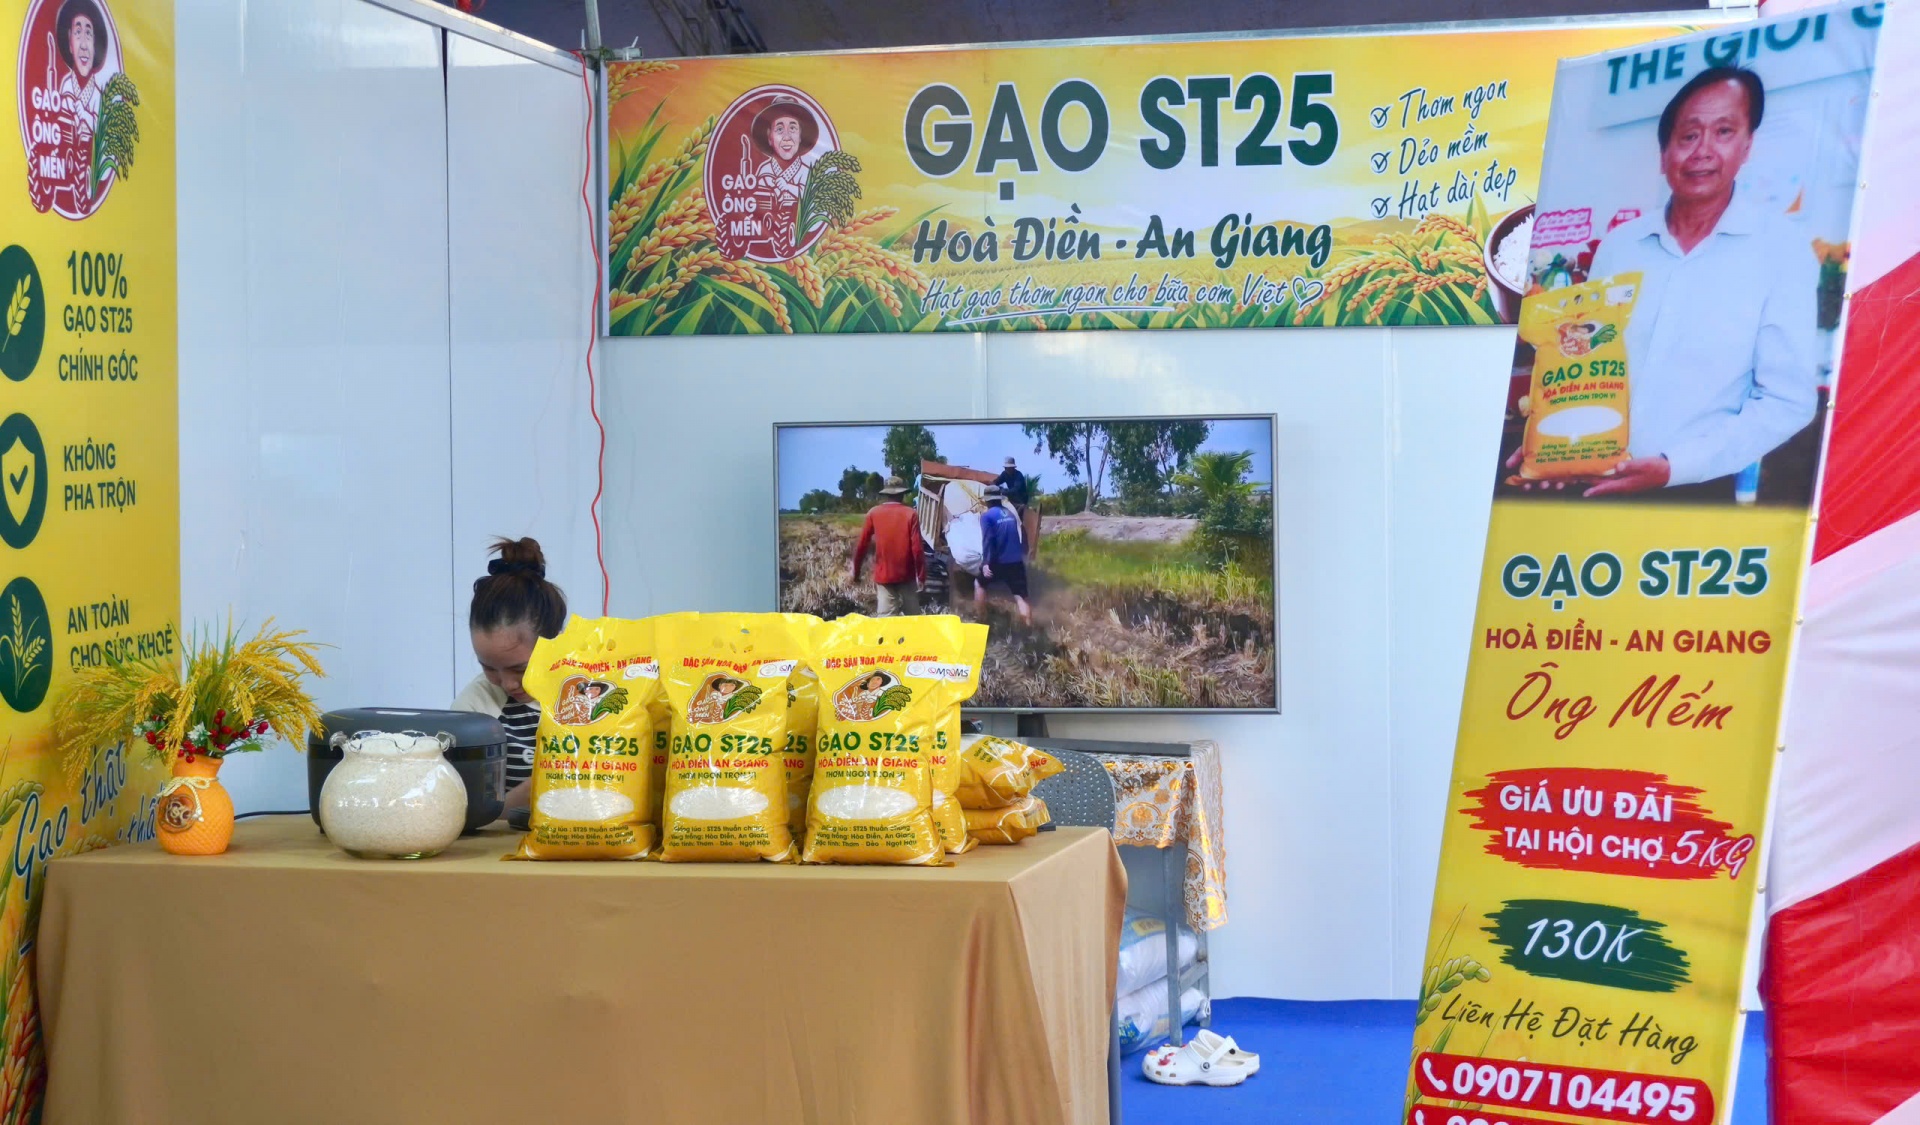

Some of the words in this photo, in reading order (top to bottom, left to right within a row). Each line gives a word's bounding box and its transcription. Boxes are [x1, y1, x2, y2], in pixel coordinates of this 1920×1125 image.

[31, 86, 61, 117] GẠO
[1399, 88, 1455, 128] Thơm
[1463, 80, 1508, 120] ngon
[32, 115, 62, 145] ÔNG
[905, 79, 1109, 200] GẠO
[1139, 73, 1339, 171] ST25
[39, 149, 66, 180] MẾN
[1399, 137, 1439, 175] Dẻo
[1447, 123, 1489, 159] mềm
[722, 173, 757, 195] GẠO
[1398, 179, 1441, 221] Hạt
[1447, 170, 1478, 203] dài
[1483, 159, 1517, 202] đẹp
[721, 195, 757, 213] ÔNG
[730, 213, 762, 237] MẾN
[913, 216, 999, 265] Hoà
[1010, 202, 1100, 262] Điền
[1135, 214, 1196, 260] An
[1210, 212, 1333, 269] Giang
[67, 250, 128, 299] 100%
[919, 278, 962, 313] Hạt
[966, 286, 1000, 319] gạo
[1009, 276, 1056, 308] thơm
[1061, 284, 1108, 316] ngon
[1112, 273, 1148, 304] cho
[1154, 273, 1189, 304] bữa
[1196, 280, 1232, 304] cơm
[1241, 271, 1287, 314] Việt
[63, 305, 96, 339] GẠO
[100, 307, 133, 334] ST25
[58, 347, 104, 382] CHÍNH
[107, 348, 138, 381] GỐC
[1541, 363, 1583, 387] GẠO
[1589, 359, 1626, 378] ST25
[1568, 393, 1590, 402] NGON
[1583, 382, 1596, 392] AN
[1598, 381, 1625, 392] GIANG
[63, 437, 117, 472] KHÔNG
[64, 483, 95, 512] PHA
[97, 476, 136, 513] TRỘN
[1502, 552, 1622, 610] GẠO
[1640, 548, 1769, 596] ST25
[67, 606, 88, 635] AN
[91, 594, 130, 629] TOÀN
[70, 645, 102, 674] CHO
[105, 631, 135, 667] SỨC
[137, 623, 174, 660] KHOẺ
[1485, 622, 1538, 650] HOÀ
[1546, 618, 1603, 651] ĐIỀN
[1625, 630, 1664, 652] AN
[1673, 629, 1771, 654] GIANG
[682, 657, 700, 669] ĐẶC
[1506, 661, 1597, 740] Ông
[588, 735, 639, 757] ST25
[671, 733, 712, 759] GẠO
[720, 734, 773, 756] ST25
[818, 731, 862, 757] GẠO
[869, 731, 920, 753] ST25
[818, 756, 834, 768] HÒA
[836, 753, 859, 767] ĐIỀN
[864, 757, 879, 767] AN
[882, 757, 918, 769] GIANG
[602, 760, 637, 772] GIANG
[671, 757, 686, 770] HÒA
[715, 759, 730, 768] AN
[733, 759, 769, 768] GIANG
[1030, 757, 1048, 769] 5KG
[14, 791, 68, 901] Gạo
[80, 740, 127, 827] thật
[1562, 785, 1603, 817] ƯU
[1614, 787, 1673, 823] ĐÃI
[1504, 826, 1540, 855] TẠI
[1548, 826, 1593, 860] HỘI
[1601, 835, 1664, 867] CHỢ
[1671, 830, 1754, 877] 5KG
[1523, 918, 1644, 963] 130K
[1441, 993, 1494, 1028] Liên
[1502, 998, 1543, 1039] Hệ
[1552, 1006, 1613, 1047] Đặt
[1619, 1011, 1698, 1065] Hàng
[1452, 1062, 1697, 1122] 0907104495
